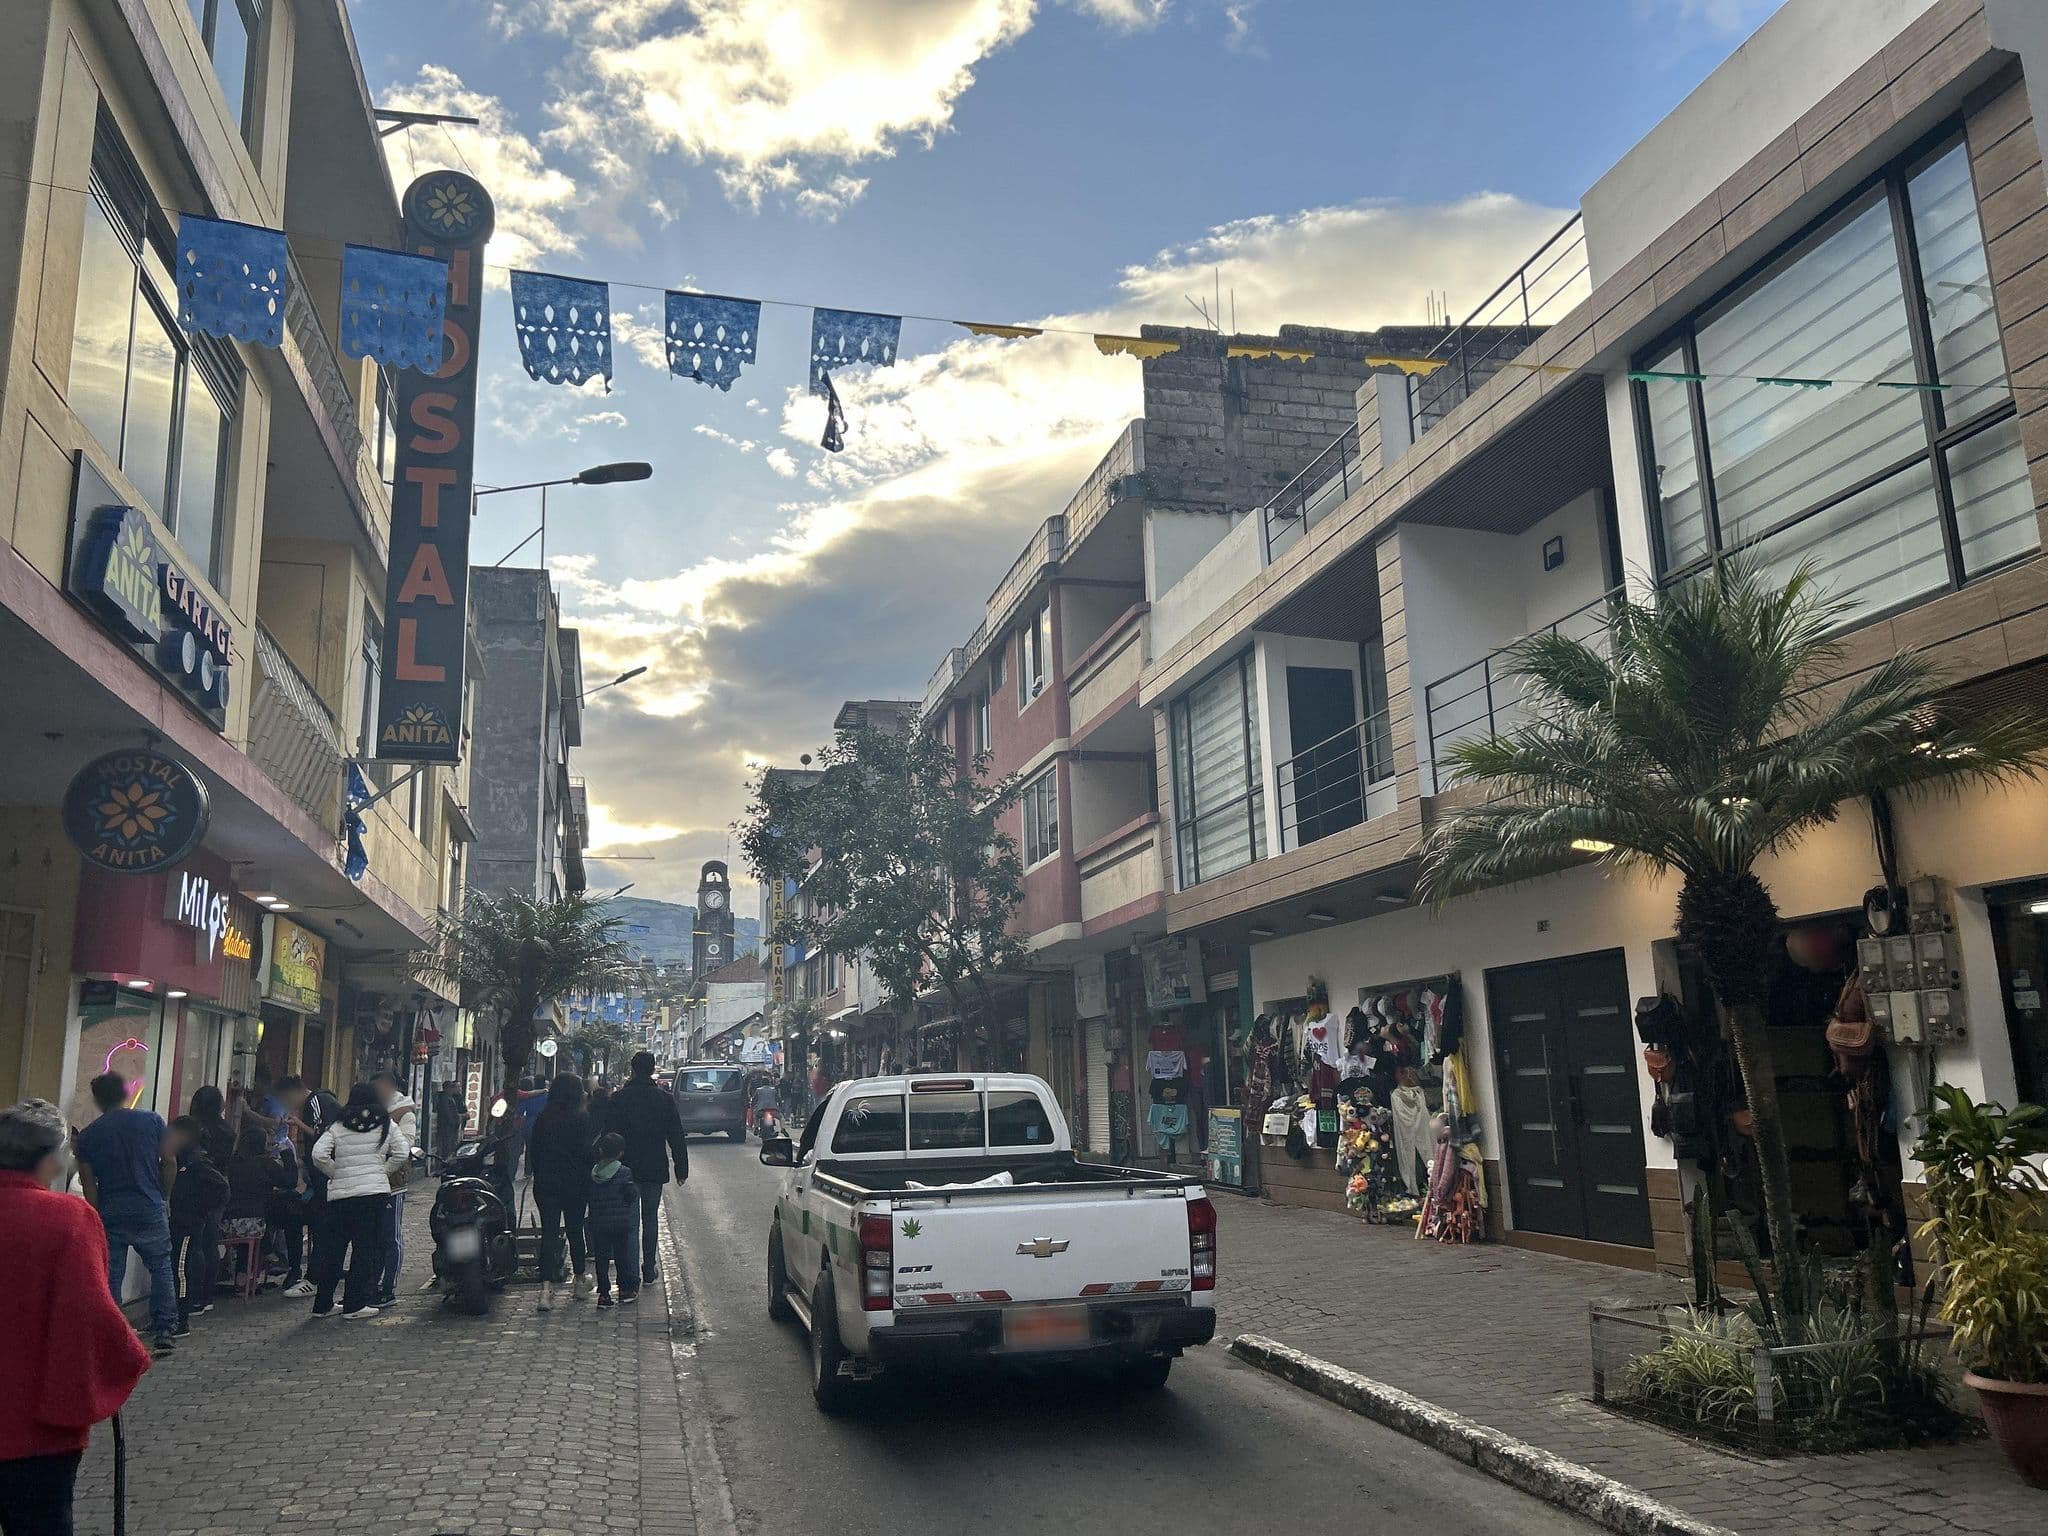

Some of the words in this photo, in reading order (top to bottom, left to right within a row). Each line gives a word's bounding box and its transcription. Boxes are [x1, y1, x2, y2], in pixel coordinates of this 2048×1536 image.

[105, 540, 161, 631] ANITA
[165, 563, 235, 665] GARAGE
[382, 724, 450, 744] ANITA
[98, 755, 183, 790] HOSTAL
[92, 843, 166, 866] ANITA
[773, 881, 784, 920] STAL
